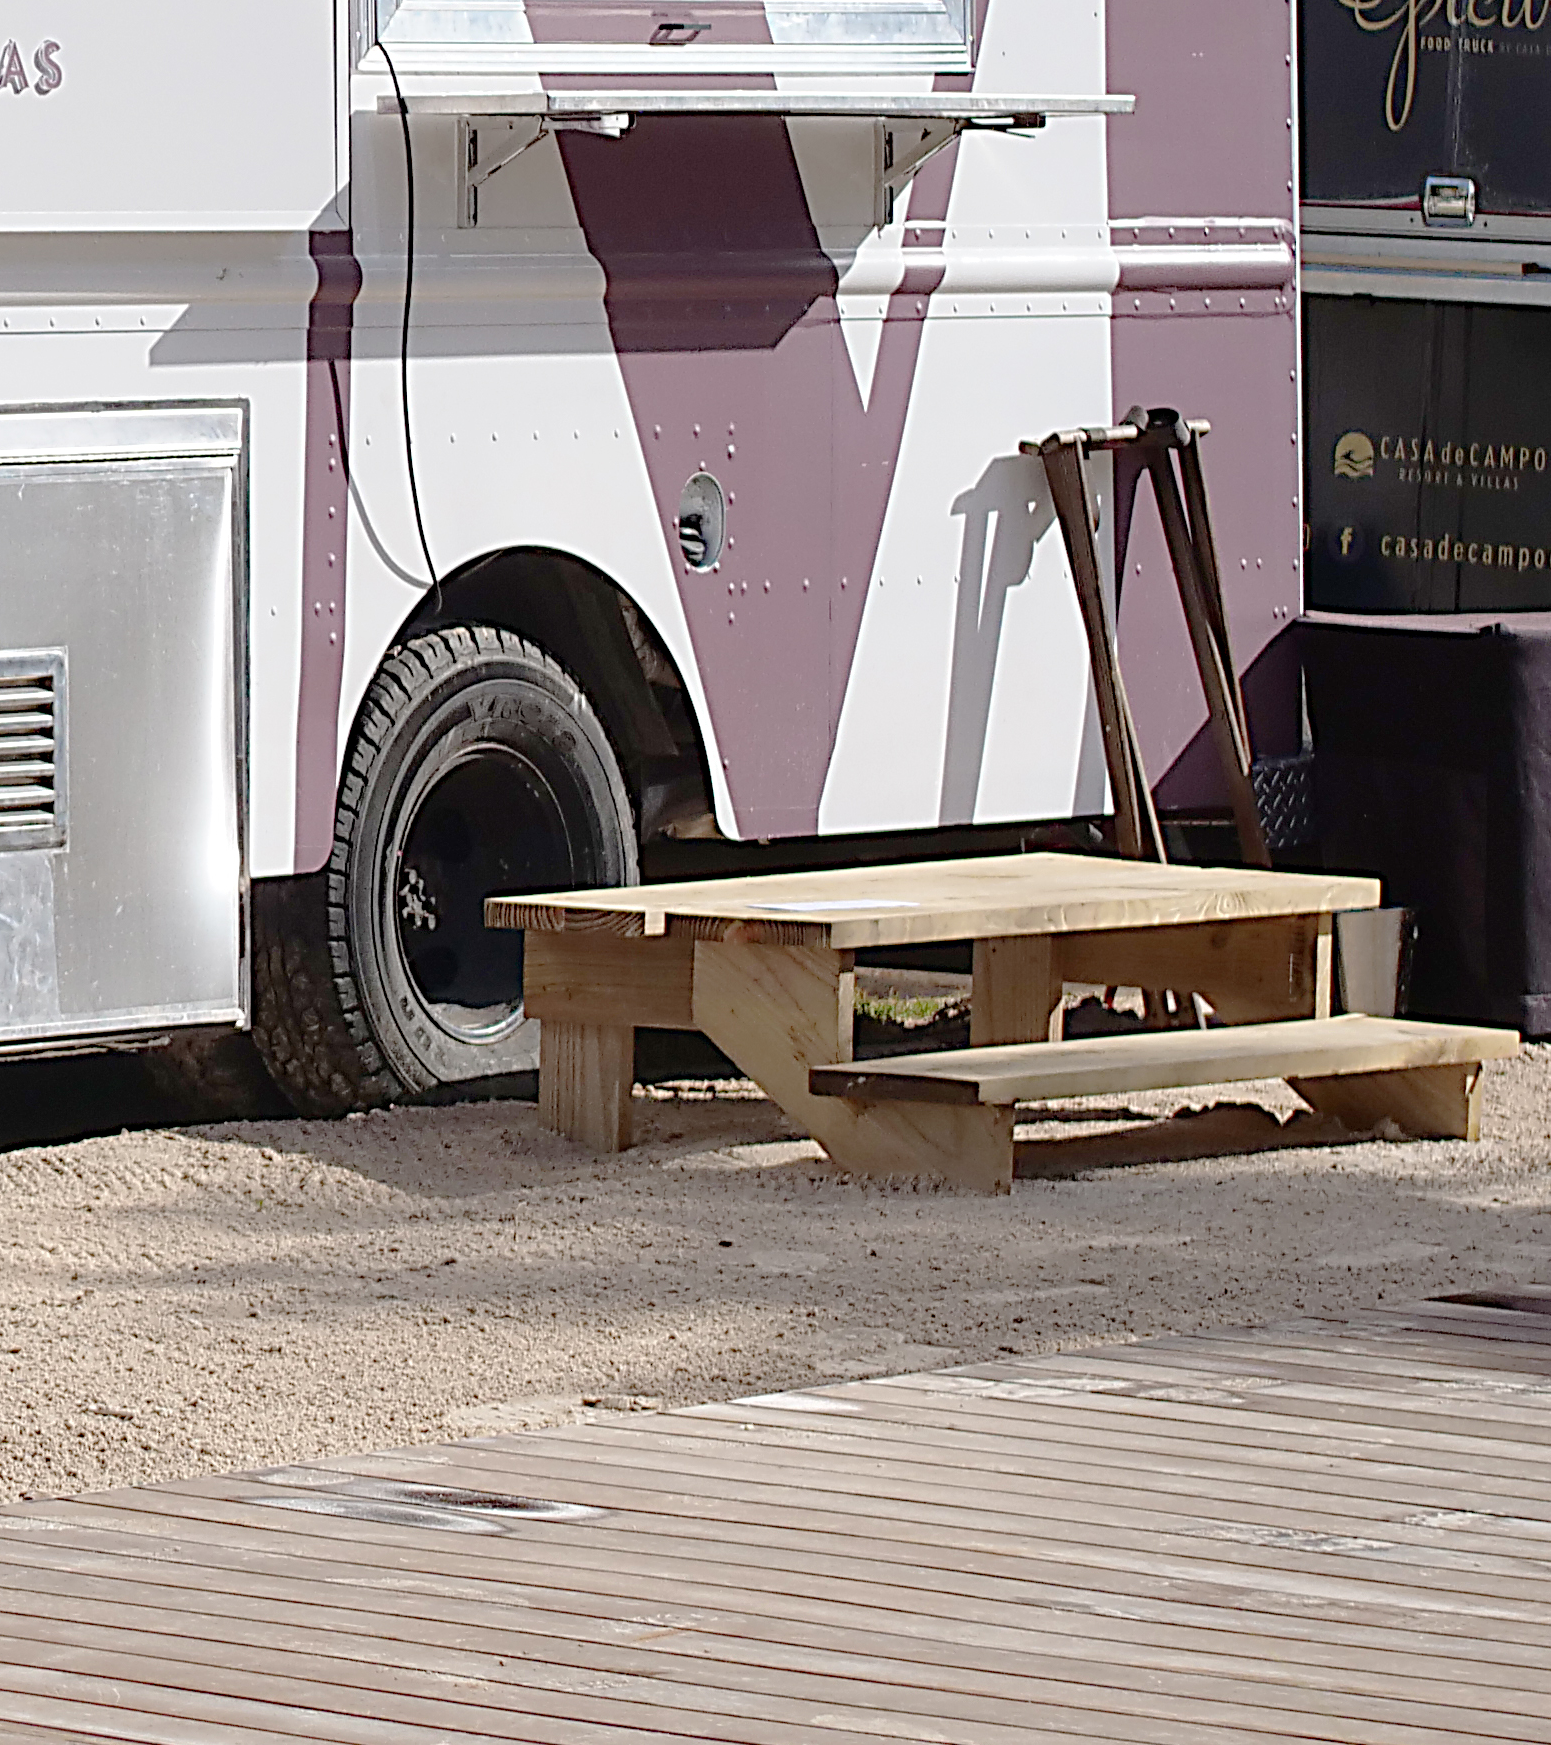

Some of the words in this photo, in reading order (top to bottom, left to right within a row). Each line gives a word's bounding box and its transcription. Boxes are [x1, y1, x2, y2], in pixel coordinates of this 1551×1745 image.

[1420, 36, 1451, 52] FOOD
[1458, 37, 1494, 54] TRUCK
[1471, 472, 1519, 492] VILLAS
